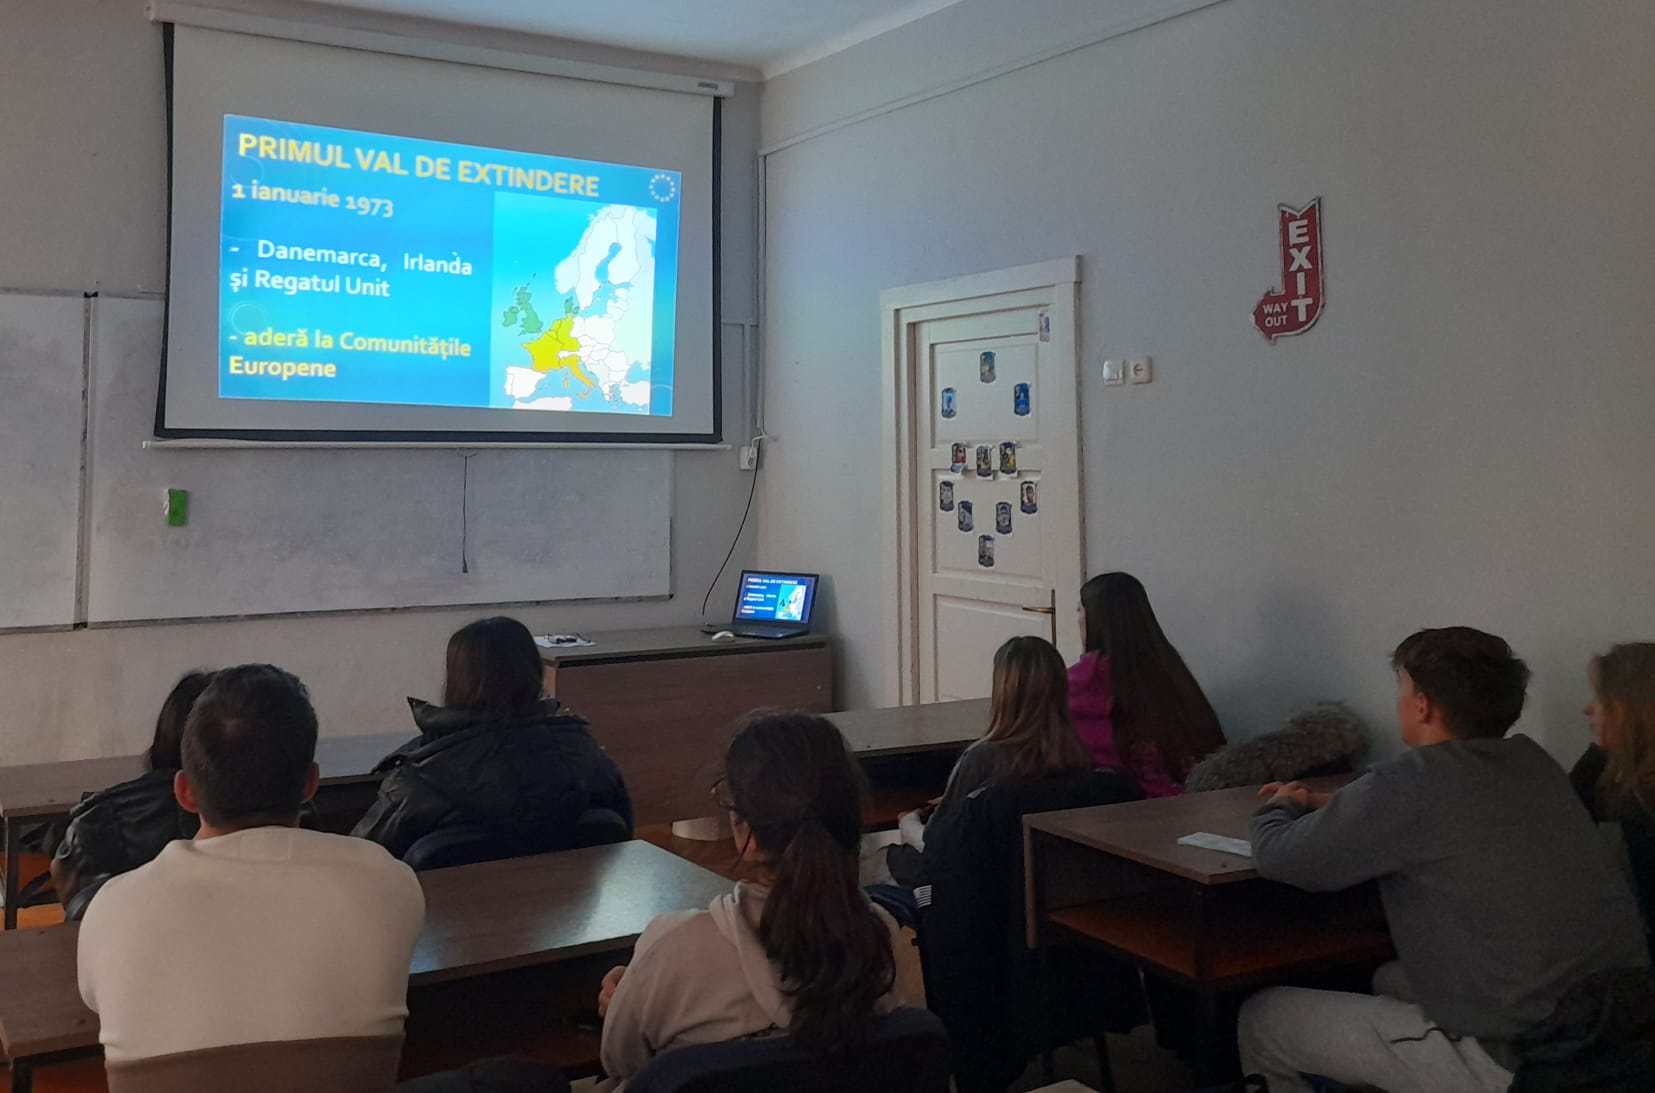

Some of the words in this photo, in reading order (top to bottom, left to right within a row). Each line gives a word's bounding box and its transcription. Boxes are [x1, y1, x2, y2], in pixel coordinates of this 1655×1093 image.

[238, 132, 351, 169] PRIMUL
[356, 147, 409, 176] VAL
[415, 155, 452, 180] DE
[458, 160, 600, 197] EXTINDERE
[232, 184, 246, 198] 1
[252, 180, 340, 208] ianuarie
[346, 195, 393, 218] 1973
[257, 240, 388, 272] Danemarca,
[404, 253, 473, 276] Irlanda
[1288, 219, 1313, 322] EXIT
[255, 270, 341, 295] Regatul
[346, 276, 391, 297] Unit
[1263, 302, 1288, 314] WAY
[1265, 315, 1287, 327] OUT
[244, 327, 308, 347] aderă
[315, 330, 334, 348] la
[229, 356, 337, 381] Europene
